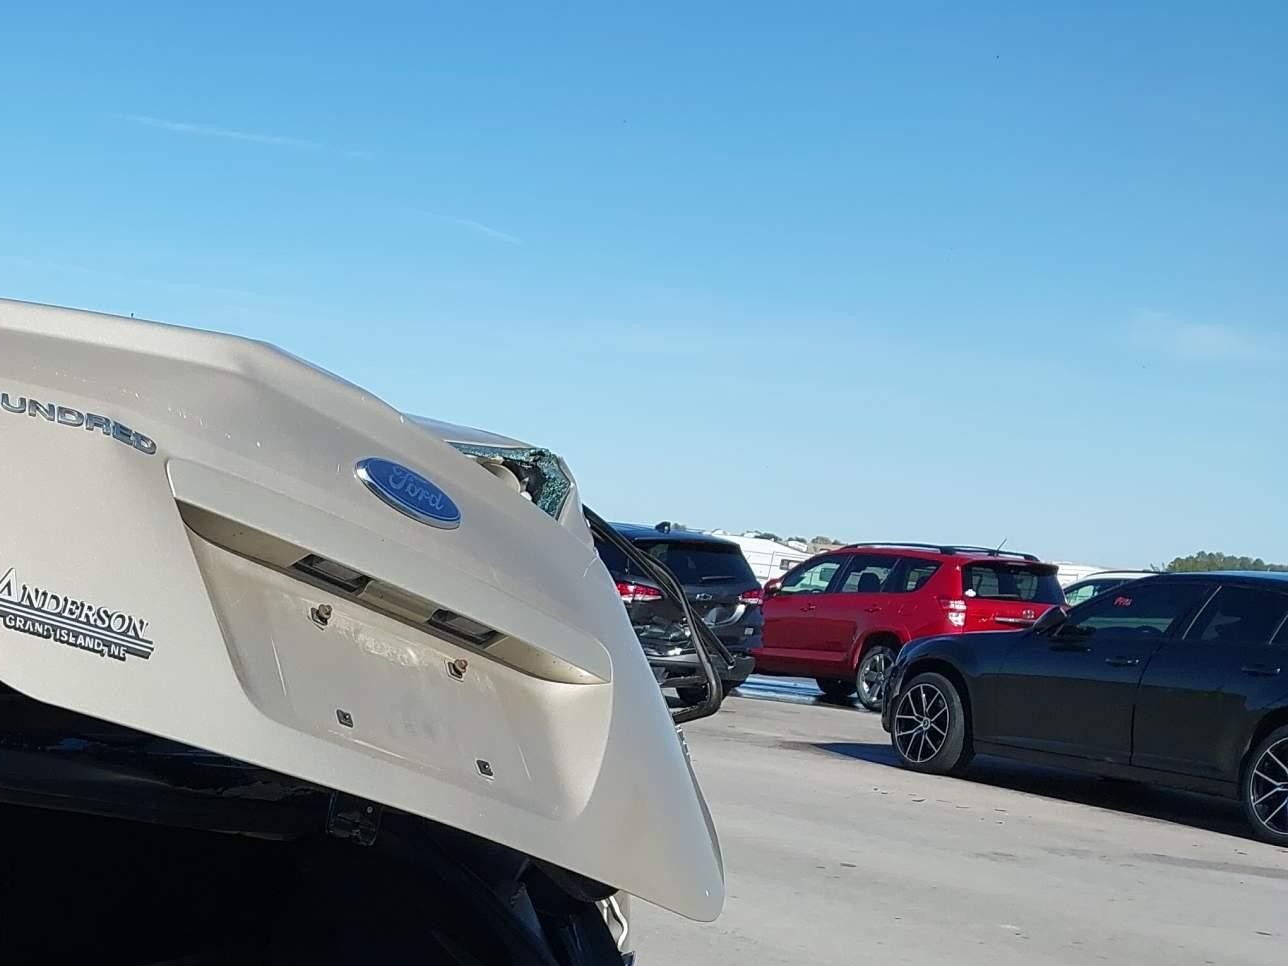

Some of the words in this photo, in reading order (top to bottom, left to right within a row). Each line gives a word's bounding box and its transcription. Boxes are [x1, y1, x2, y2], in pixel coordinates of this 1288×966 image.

[388, 465, 444, 511] Ford
[4, 614, 52, 639] GRAND
[110, 644, 127, 660] NE
